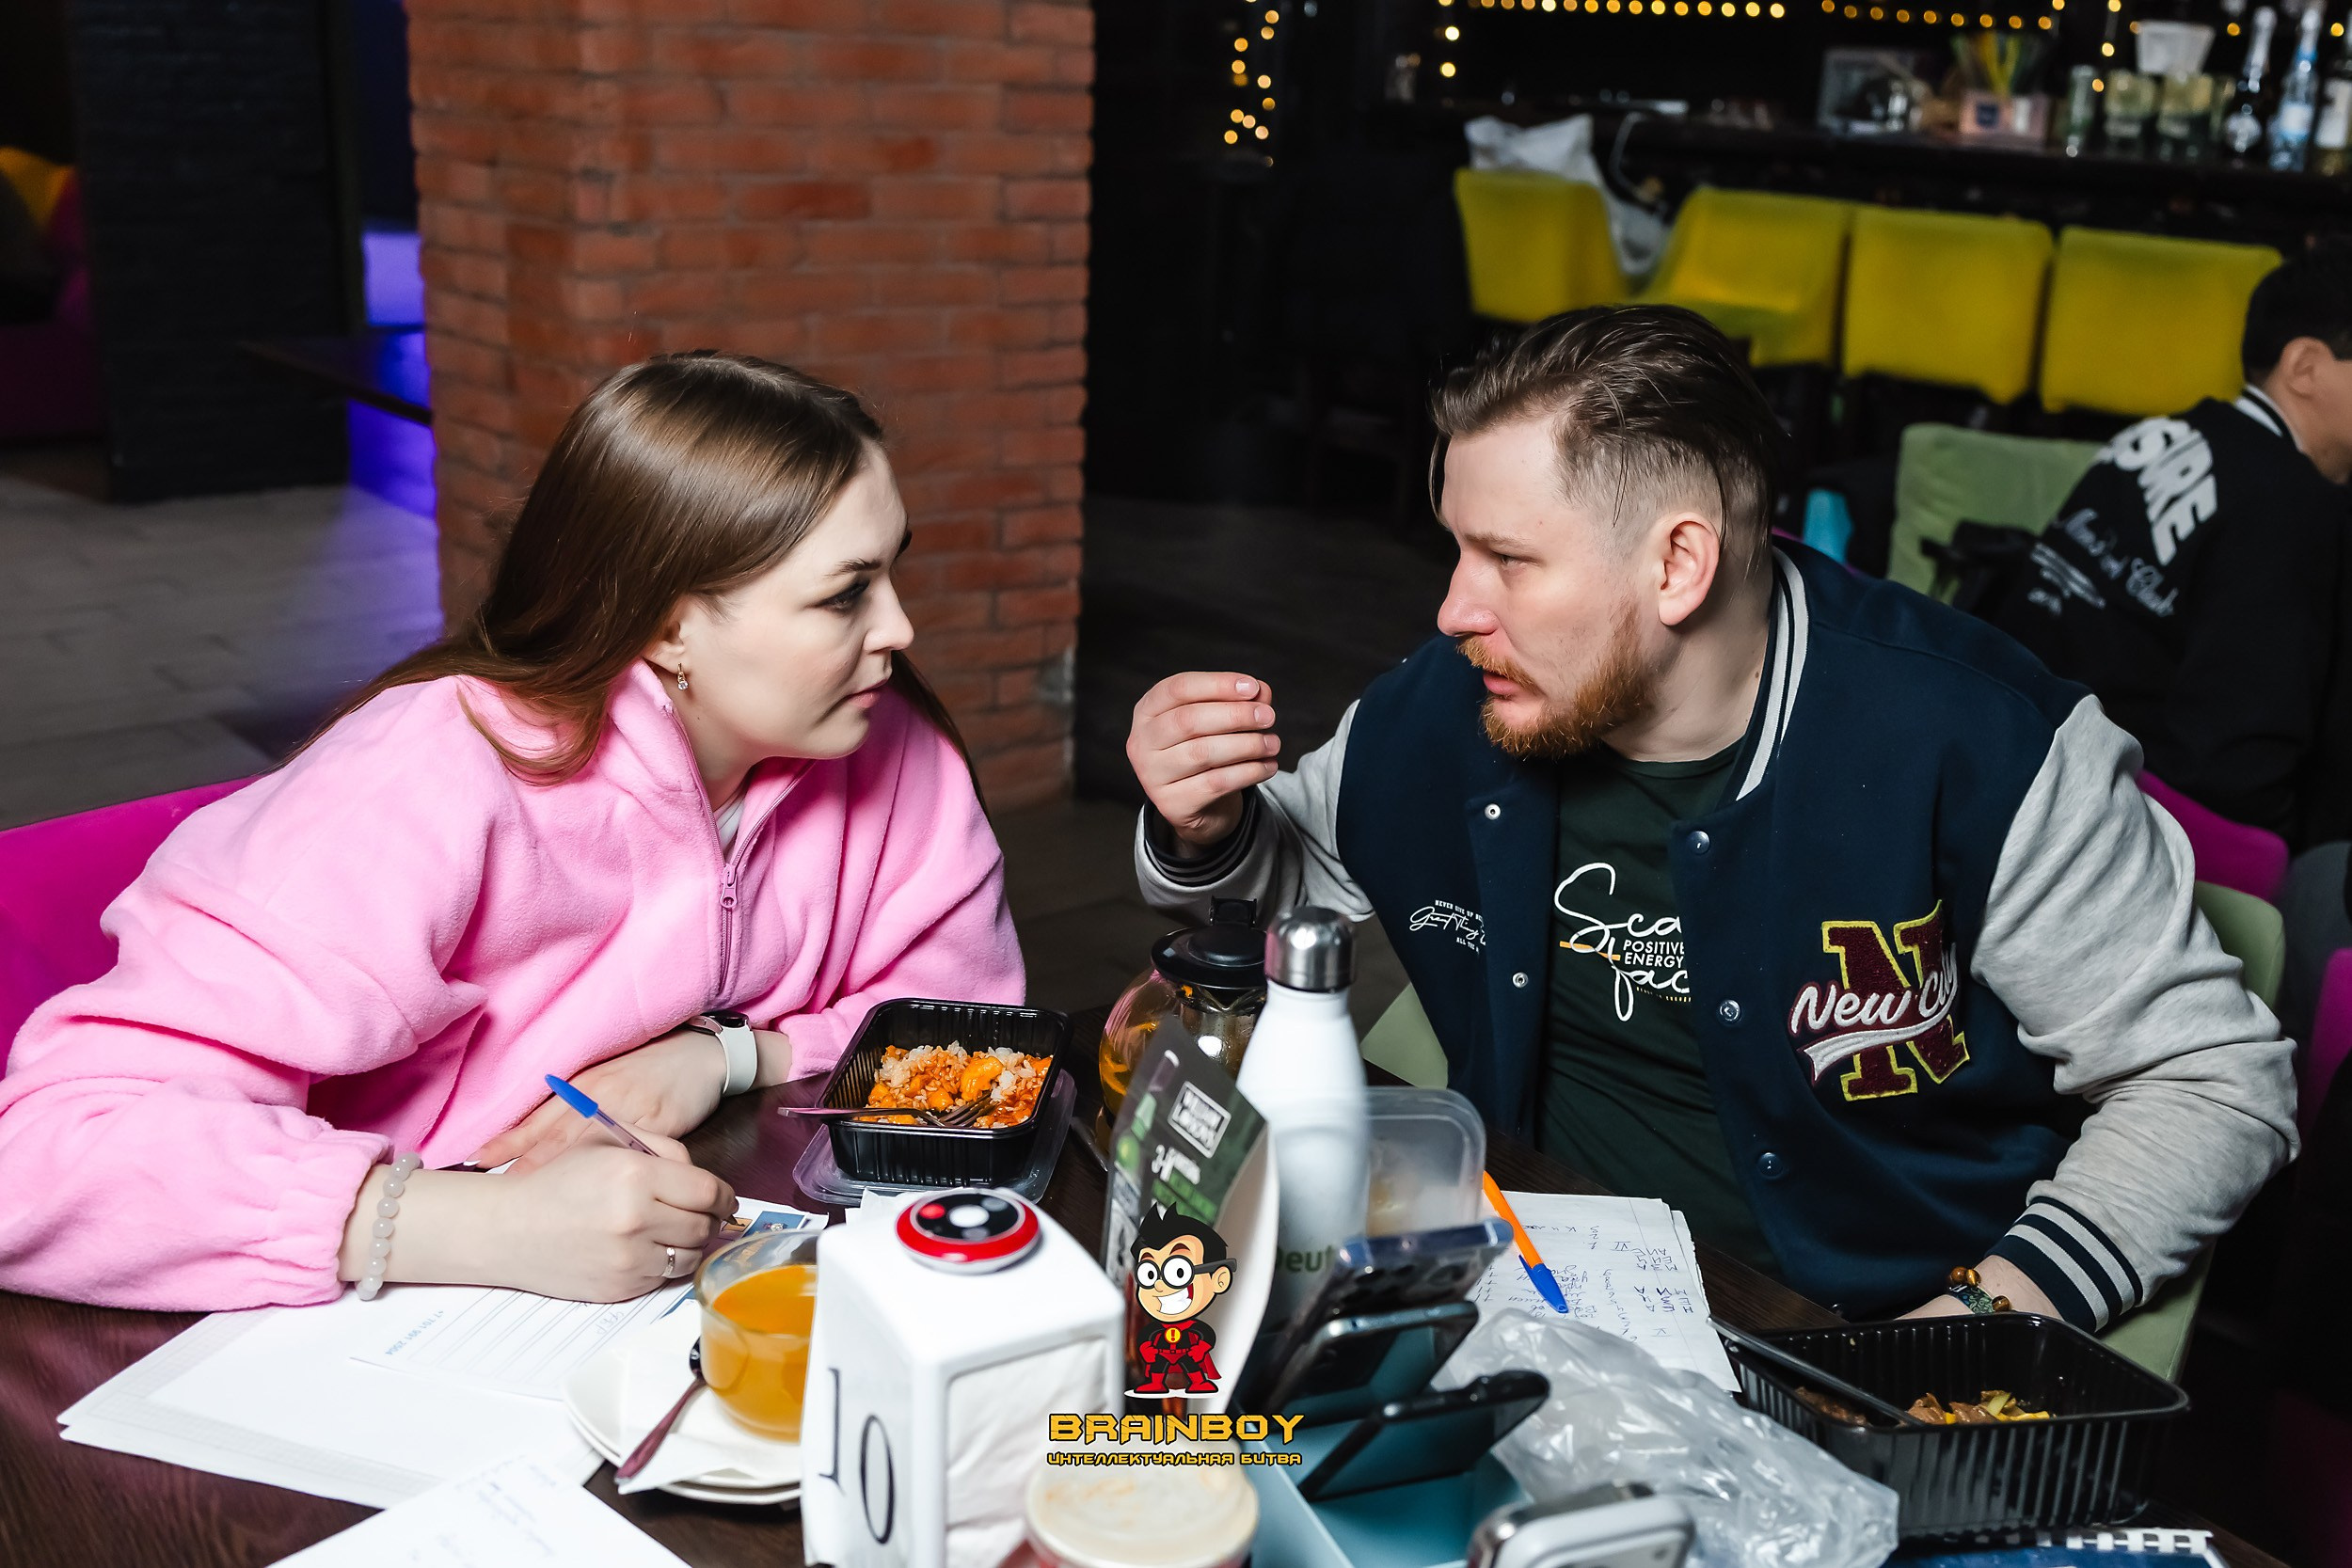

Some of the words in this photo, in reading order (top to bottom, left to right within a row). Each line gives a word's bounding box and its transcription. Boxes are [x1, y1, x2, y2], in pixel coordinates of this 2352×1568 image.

[1623, 940, 1685, 955] POSITIVE
[1624, 952, 1684, 969] ENERGY
[1790, 984, 1912, 1034] New
[1821, 899, 1970, 1102] N
[818, 1367, 897, 1545] 10
